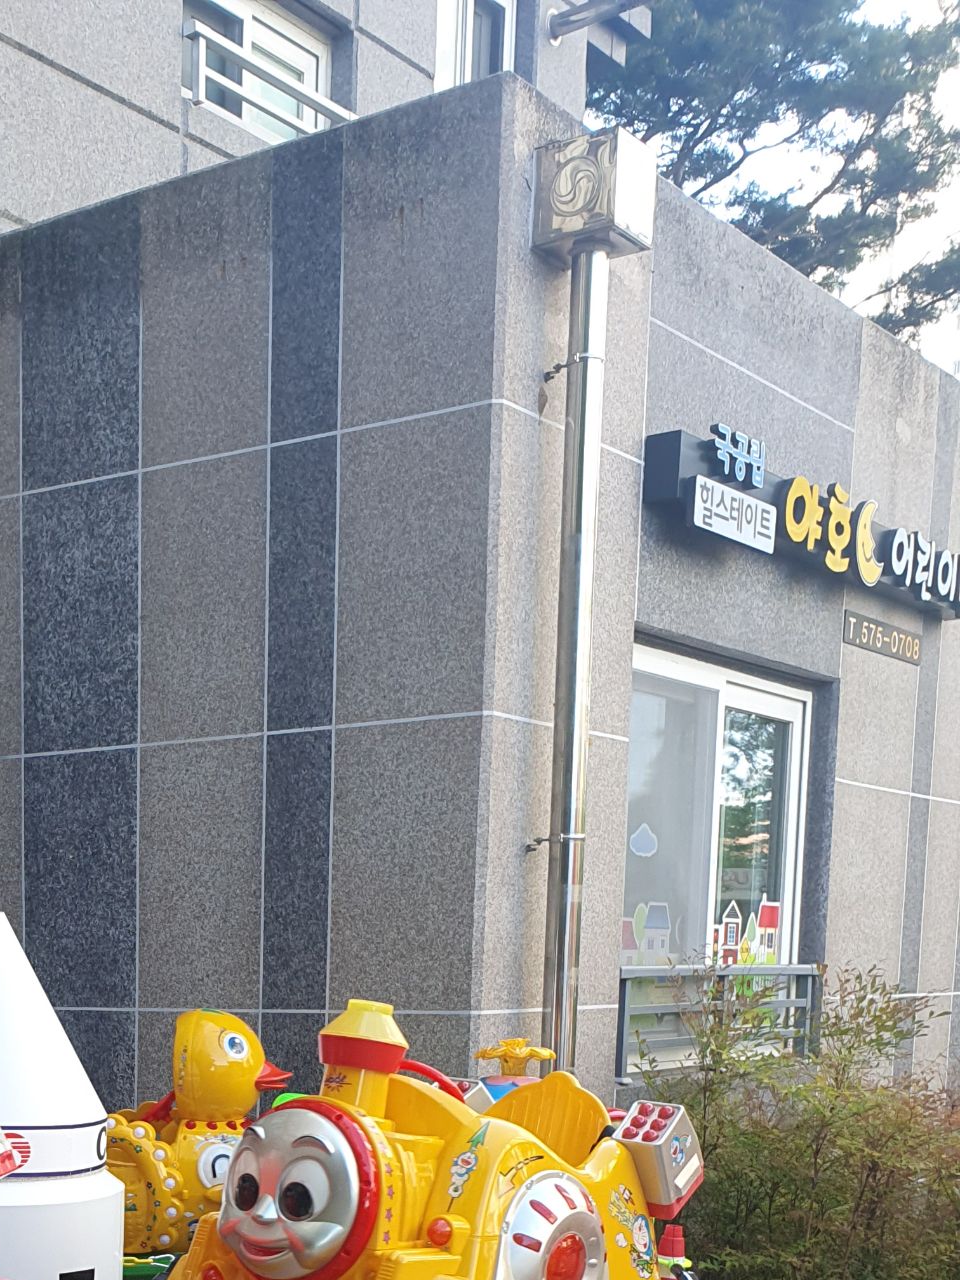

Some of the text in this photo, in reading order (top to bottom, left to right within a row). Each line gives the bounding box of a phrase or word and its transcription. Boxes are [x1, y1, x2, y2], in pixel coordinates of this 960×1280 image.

[713, 422, 766, 489] 국공립
[699, 482, 773, 541] 힐스테이트
[785, 475, 854, 573] 야호
